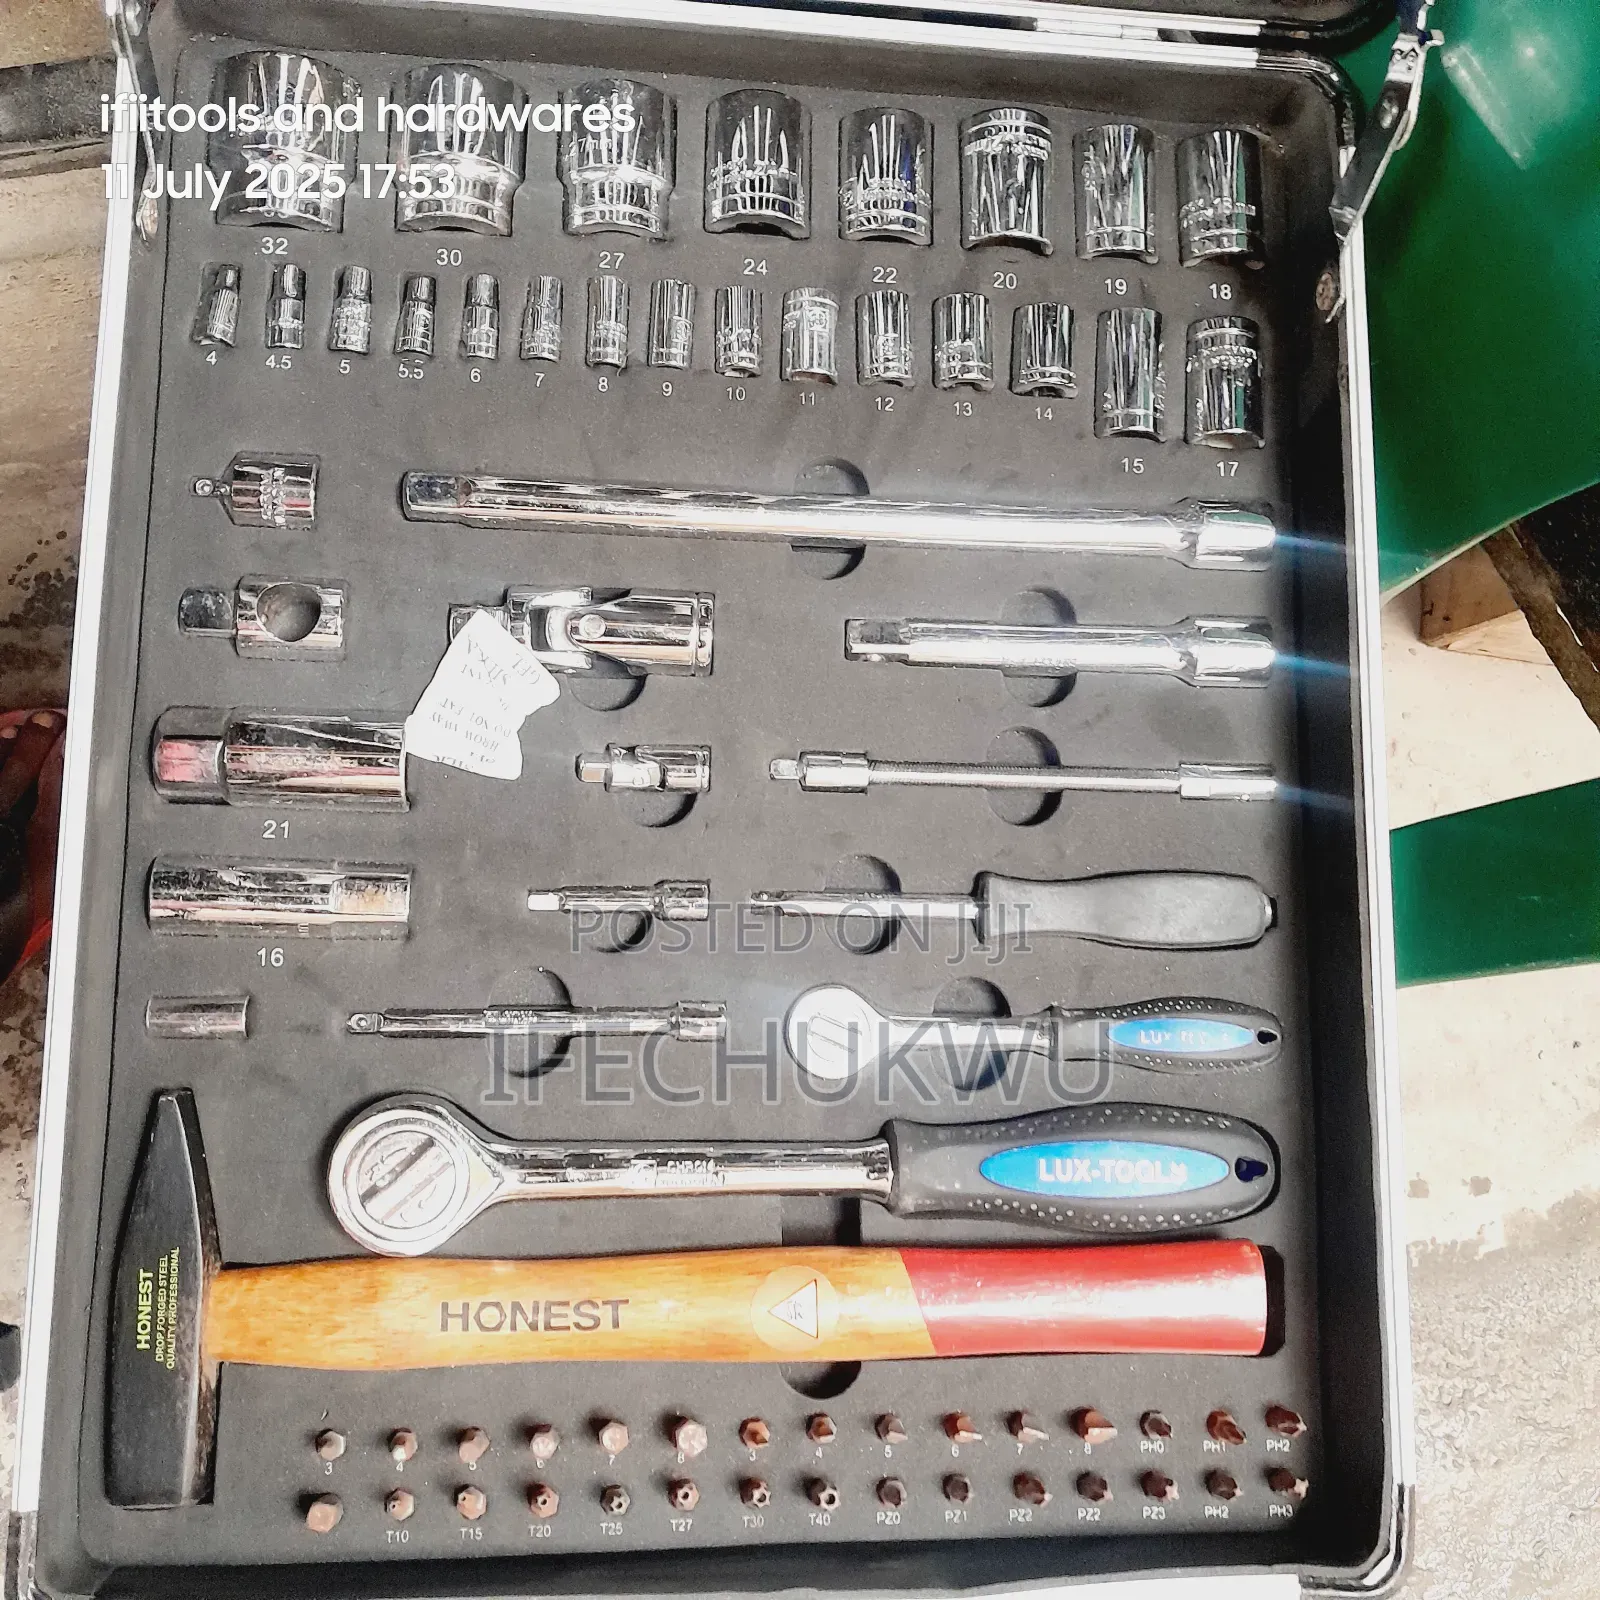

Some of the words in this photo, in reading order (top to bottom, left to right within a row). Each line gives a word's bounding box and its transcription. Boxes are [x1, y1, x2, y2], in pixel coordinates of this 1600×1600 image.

[261, 236, 288, 255] 32
[436, 248, 462, 266] 30
[598, 251, 625, 270] 27
[743, 258, 768, 276] 24
[872, 266, 897, 284] 22
[993, 271, 1017, 290] 20
[1104, 278, 1127, 295] 19
[1209, 283, 1232, 300] 18
[205, 350, 217, 366] 4
[265, 354, 292, 370] 4.5
[339, 359, 351, 374] 5
[398, 363, 424, 380] 5.5
[470, 368, 481, 383] 6
[535, 372, 545, 387] 7
[598, 376, 609, 392] 8
[662, 381, 673, 397] 9
[726, 386, 746, 401] 10
[799, 391, 815, 406] 11
[875, 396, 895, 412] 12
[954, 401, 973, 417] 13
[1035, 407, 1053, 421] 14
[1121, 457, 1145, 474] 15
[1216, 461, 1239, 477] 17
[262, 819, 289, 839] 21
[257, 947, 284, 967] 16
[159, 1255, 169, 1287] STEEL
[169, 1246, 180, 1324] PROFESSIONAL
[136, 1268, 154, 1349] HONEST
[157, 1288, 168, 1332] FORGED
[440, 1299, 630, 1332] HONEST
[155, 1331, 166, 1362] DROP
[166, 1326, 177, 1370] QUALITY
[815, 1446, 824, 1459] 4
[884, 1444, 894, 1458] 5
[951, 1443, 961, 1458] 6
[1016, 1442, 1025, 1456] 7
[1140, 1440, 1165, 1454] PH0
[1203, 1439, 1226, 1453] PH1
[1266, 1439, 1290, 1452] PH2
[609, 1454, 617, 1466] 7
[677, 1451, 686, 1464] 8
[749, 1448, 757, 1462] 3
[324, 1461, 334, 1476] 3
[395, 1460, 405, 1472] 4
[876, 1511, 901, 1525] PZ0
[944, 1509, 967, 1523] PZ1
[1009, 1507, 1033, 1522] PZ2
[1077, 1507, 1101, 1522] PZ2
[1142, 1505, 1166, 1520] PZ3
[1204, 1505, 1229, 1519] PH2
[1269, 1504, 1293, 1517] PH3
[670, 1518, 693, 1532] T27
[742, 1514, 765, 1528] T30
[808, 1512, 831, 1526] T40
[459, 1527, 483, 1540] T15
[527, 1524, 552, 1538] T20
[599, 1521, 623, 1536] T25
[385, 1529, 409, 1544] T10
